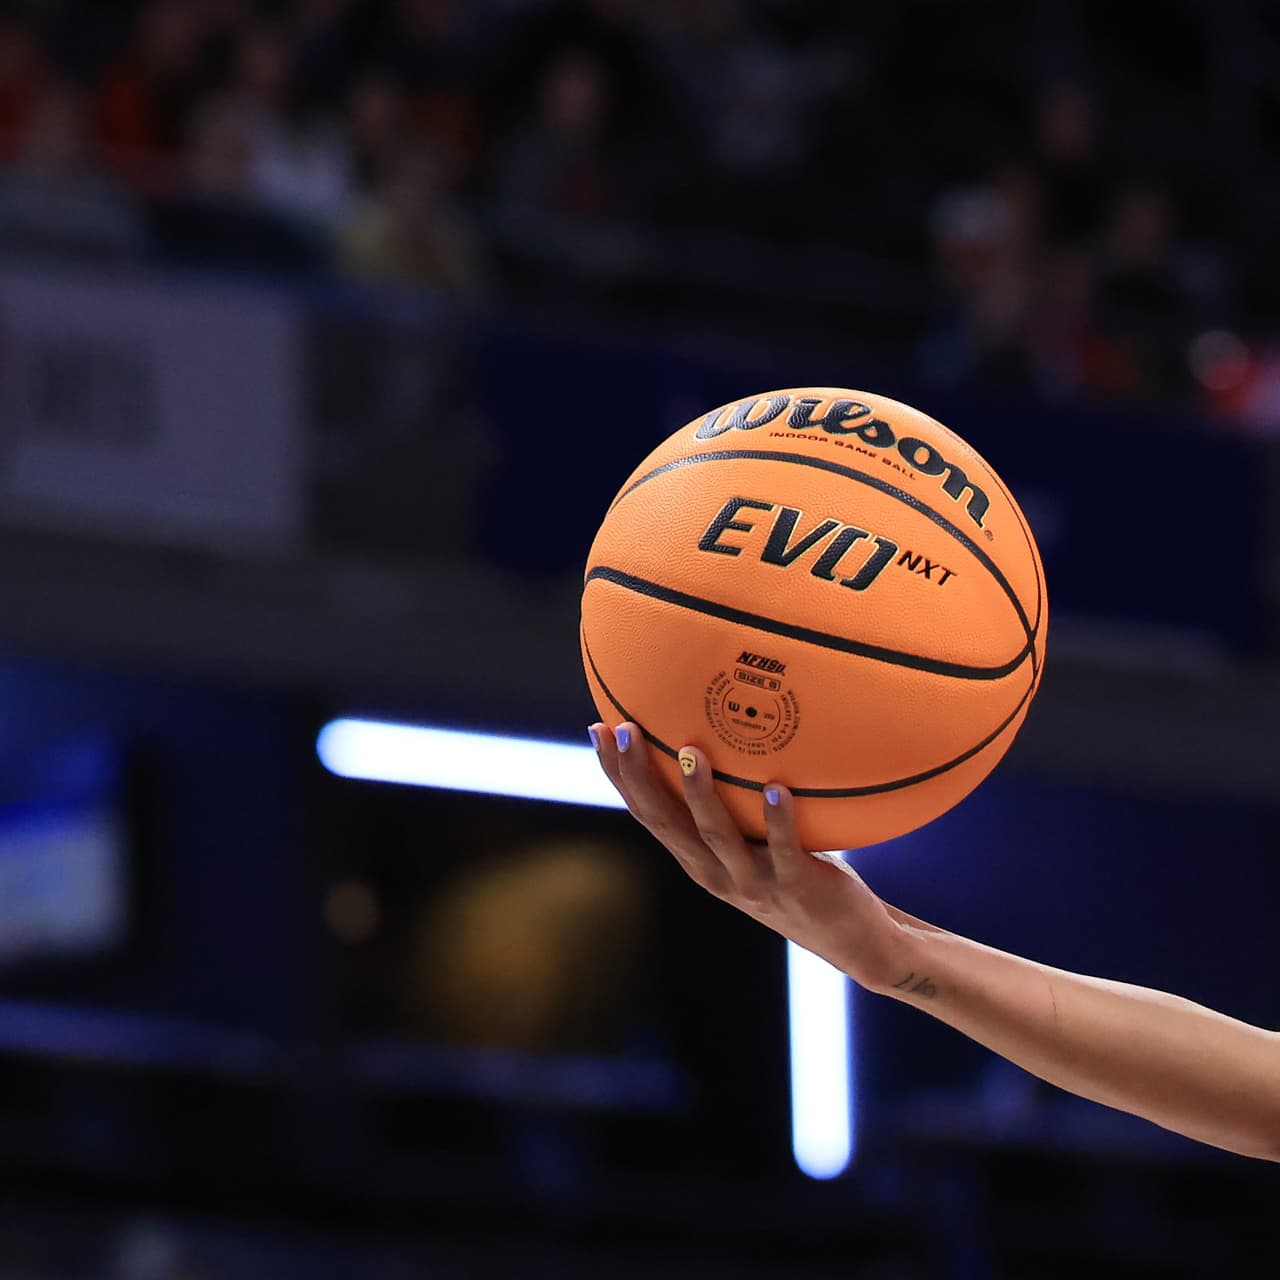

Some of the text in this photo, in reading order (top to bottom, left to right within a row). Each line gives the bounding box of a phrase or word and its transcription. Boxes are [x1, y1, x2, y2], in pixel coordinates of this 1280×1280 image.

[695, 395, 990, 529] Wilson
[769, 432, 916, 480] INDOOR GAME BALL
[698, 496, 958, 592] EVO NXT
